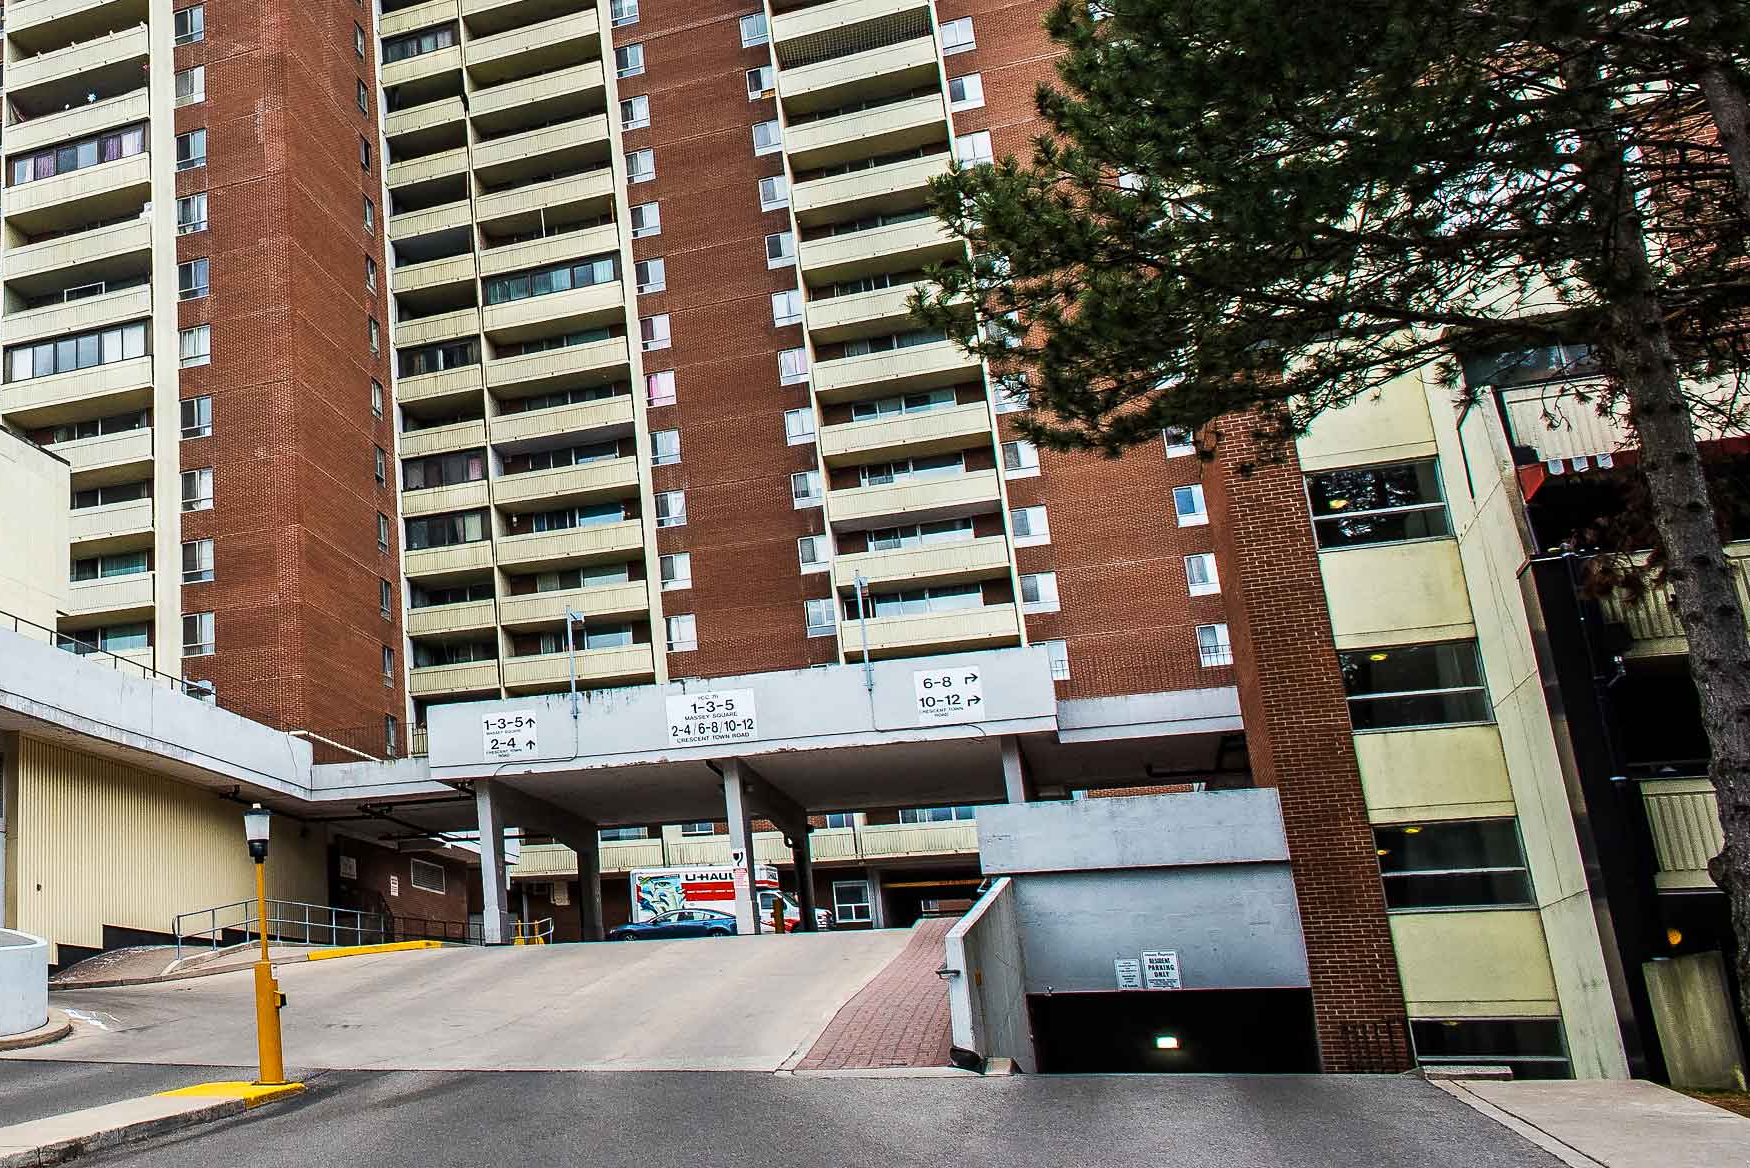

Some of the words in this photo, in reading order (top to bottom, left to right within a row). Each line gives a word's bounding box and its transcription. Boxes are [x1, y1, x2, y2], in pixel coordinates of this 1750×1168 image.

[923, 676, 952, 689] 6-8
[691, 699, 735, 714] 1-3-5
[919, 694, 961, 708] 10-12
[712, 711, 738, 719] SQUARE
[483, 716, 524, 731] 1-3-5
[490, 737, 517, 750] 2-4
[677, 735, 710, 744] CRESCENT
[685, 872, 735, 881] U-HAUL
